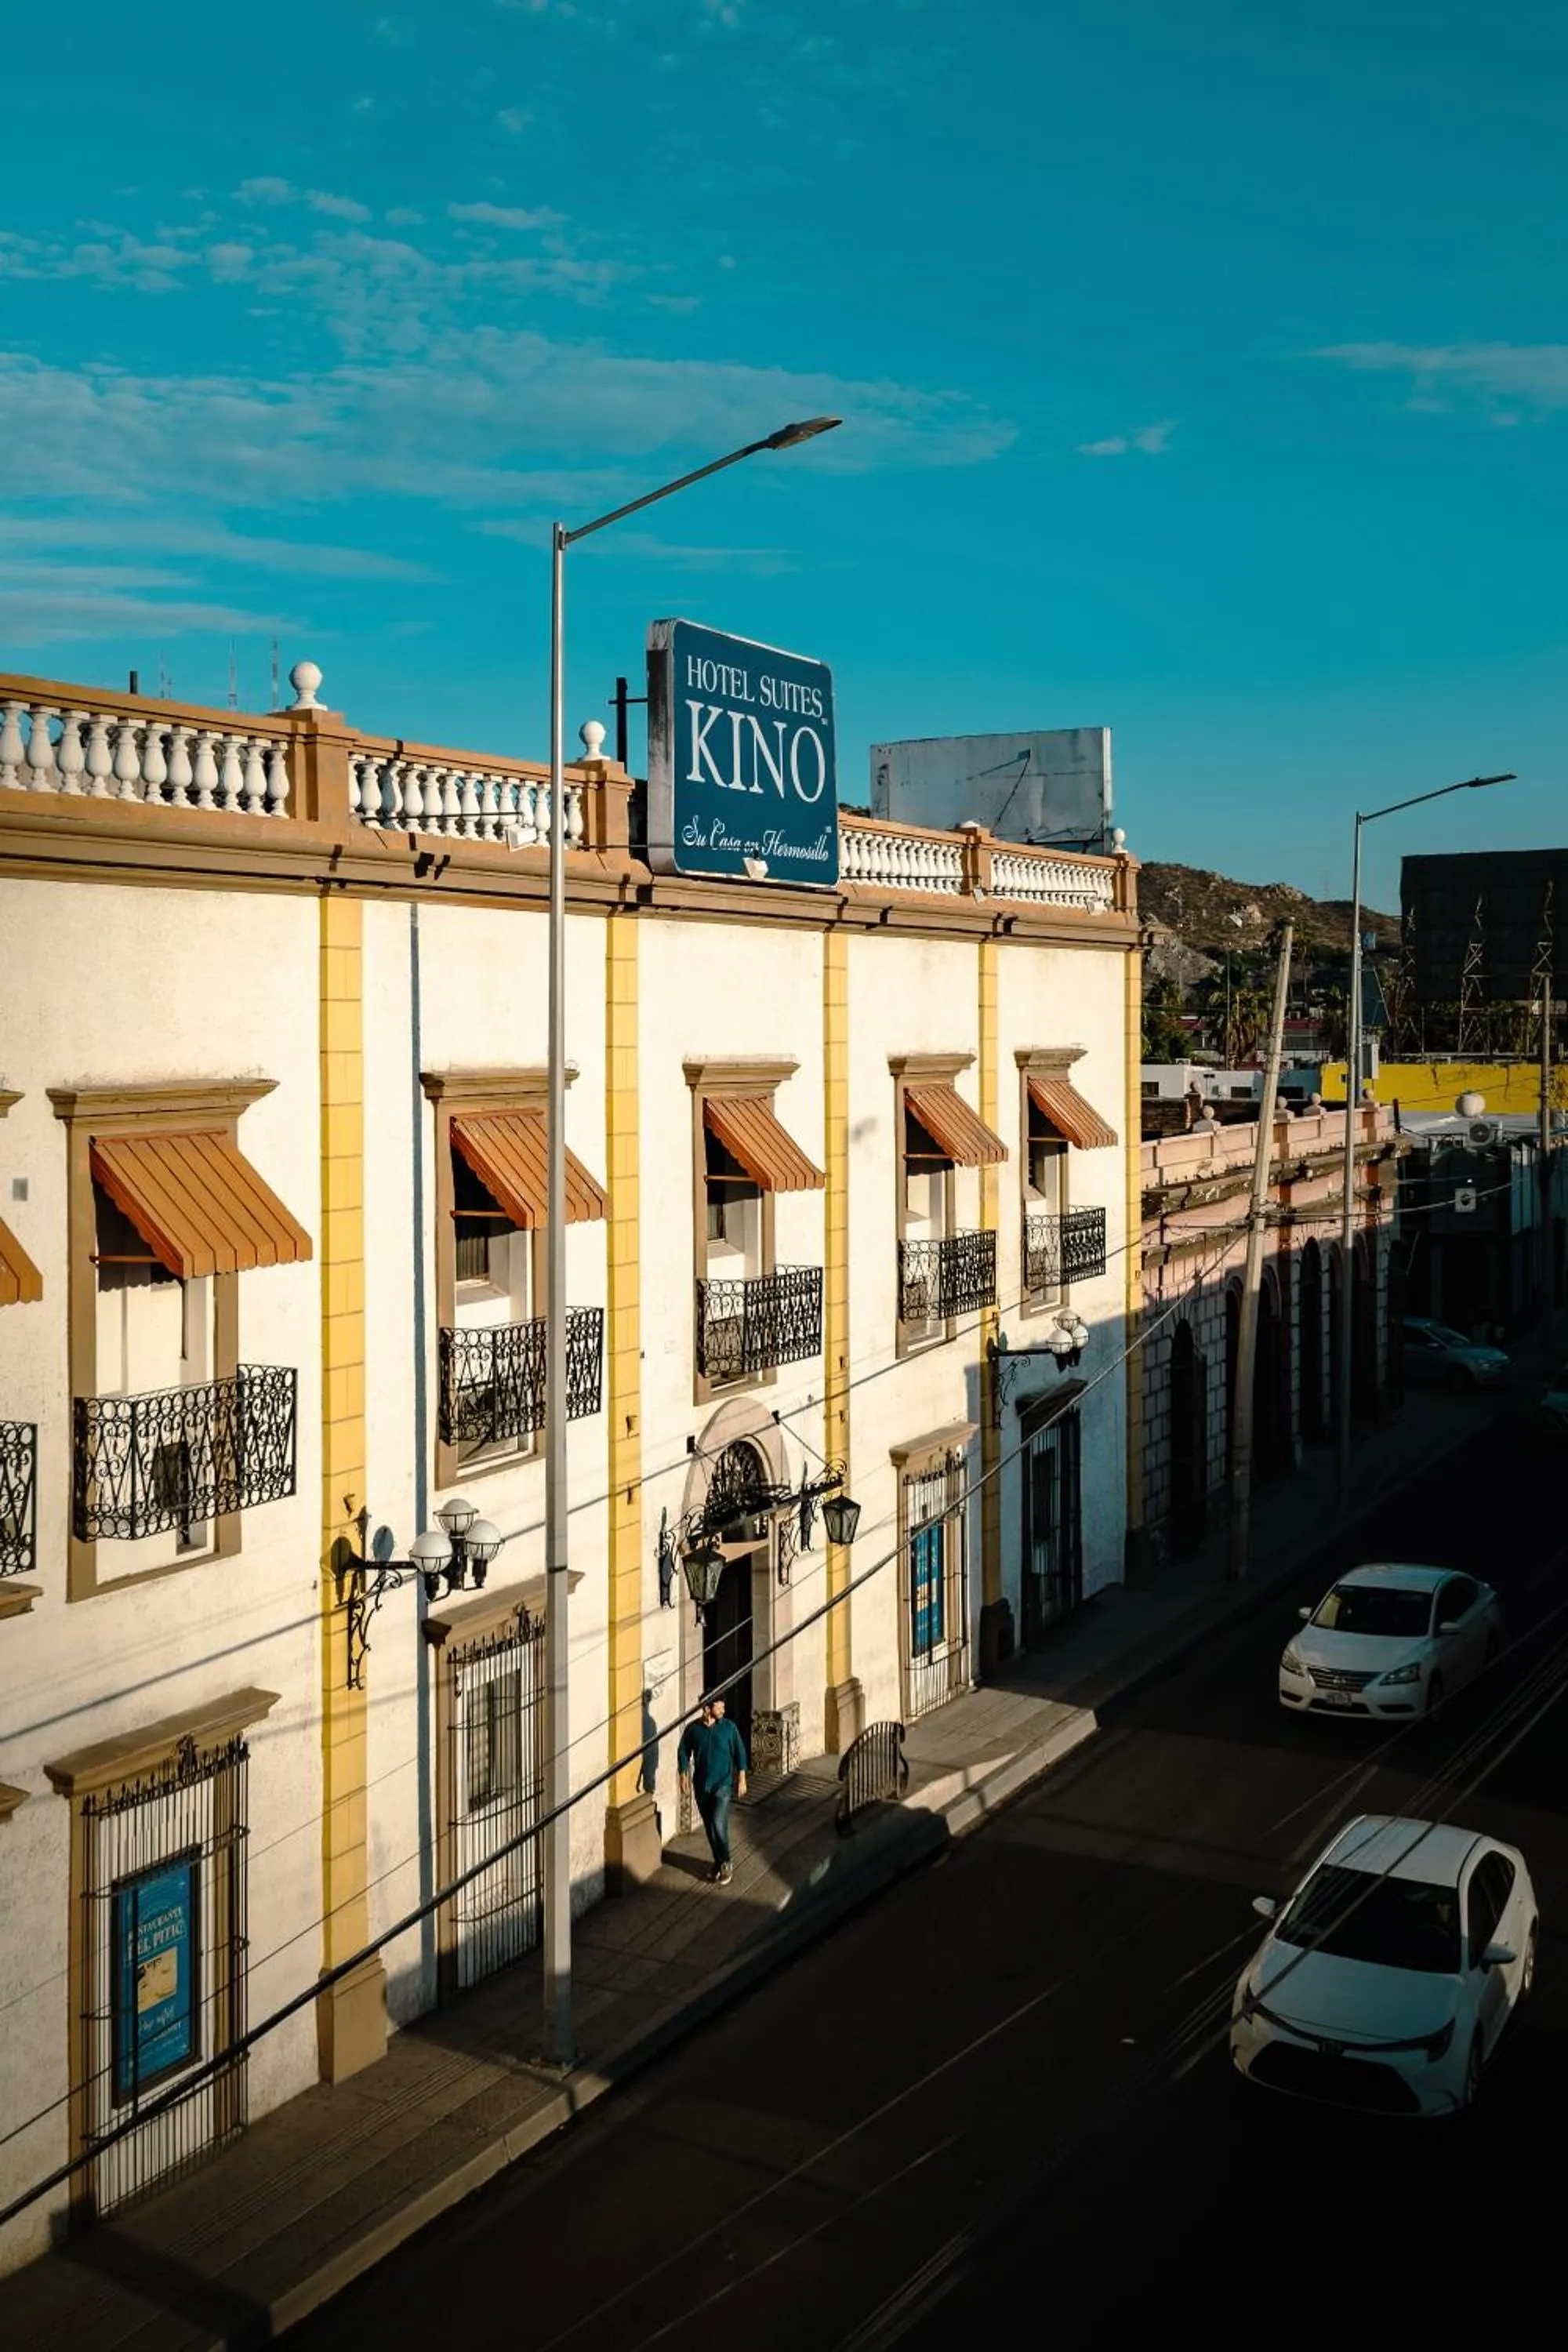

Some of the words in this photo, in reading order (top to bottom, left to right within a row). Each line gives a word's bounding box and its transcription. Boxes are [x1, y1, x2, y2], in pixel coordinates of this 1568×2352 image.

[687, 655, 755, 702] HOTEL
[760, 675, 822, 718] SUITES
[685, 699, 825, 803] KINO
[681, 815, 706, 847] Su
[710, 818, 742, 851] Casa
[761, 829, 829, 862] Hermosillo
